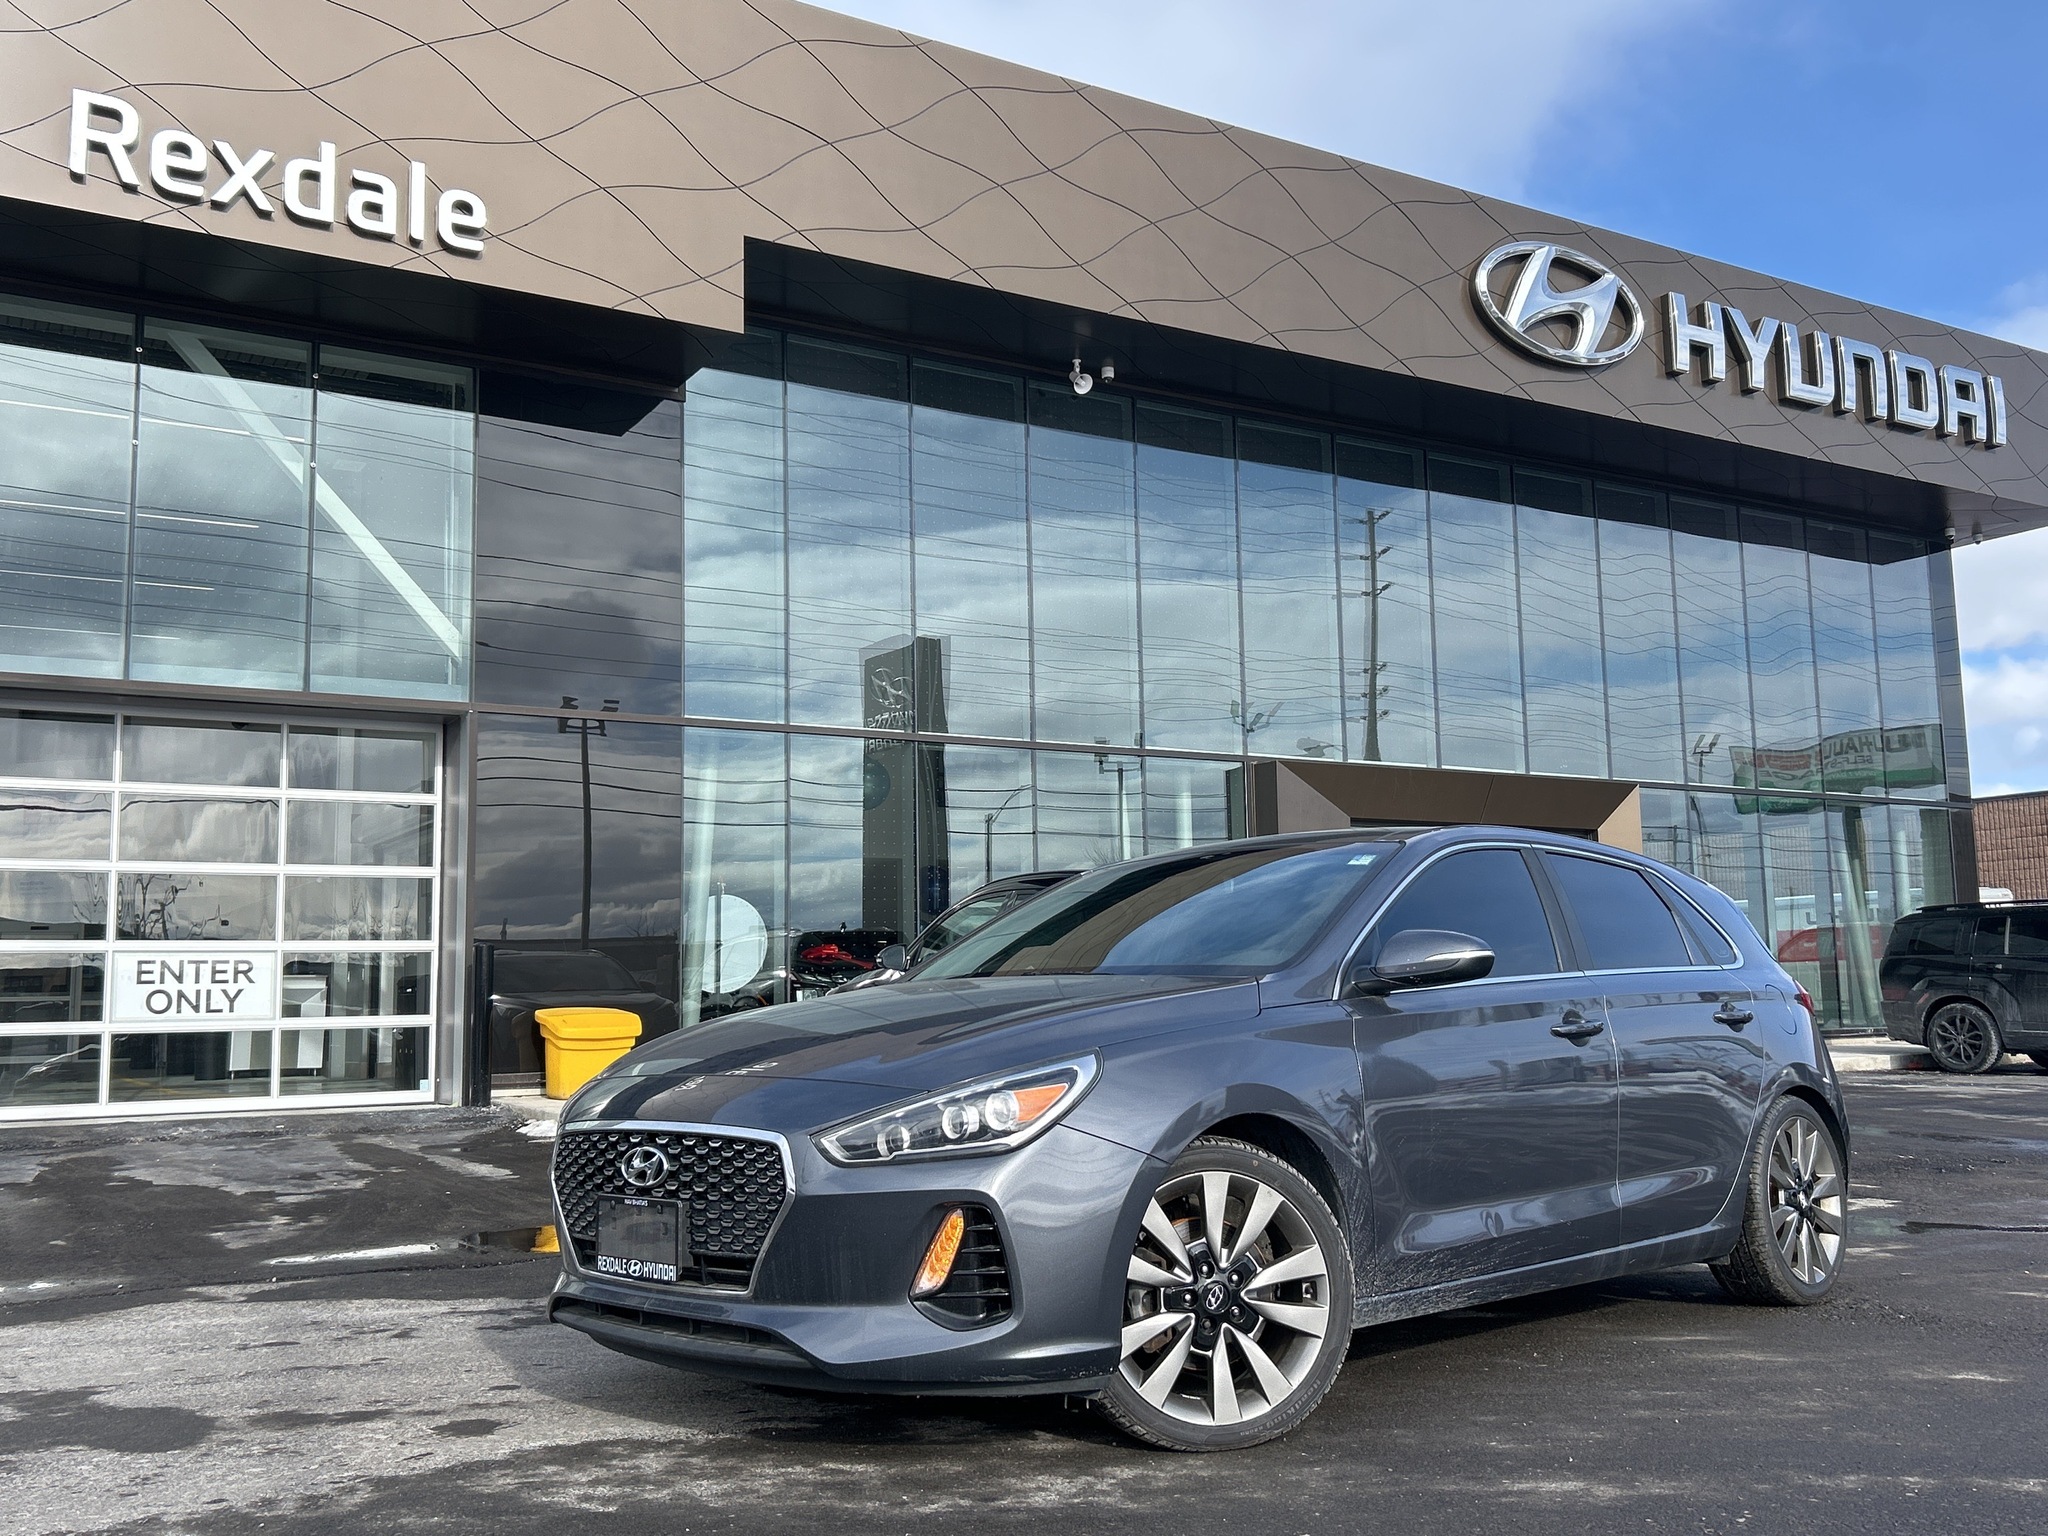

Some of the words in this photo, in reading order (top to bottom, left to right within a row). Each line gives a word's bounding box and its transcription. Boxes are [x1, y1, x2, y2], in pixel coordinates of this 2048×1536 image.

[68, 87, 488, 255] Rexdale
[1663, 291, 2008, 448] HYUNDAI
[136, 960, 255, 985] ENTER
[145, 988, 244, 1014] ONLY
[598, 1255, 627, 1274] REXDALE
[643, 1261, 677, 1281] HYUNDAI
